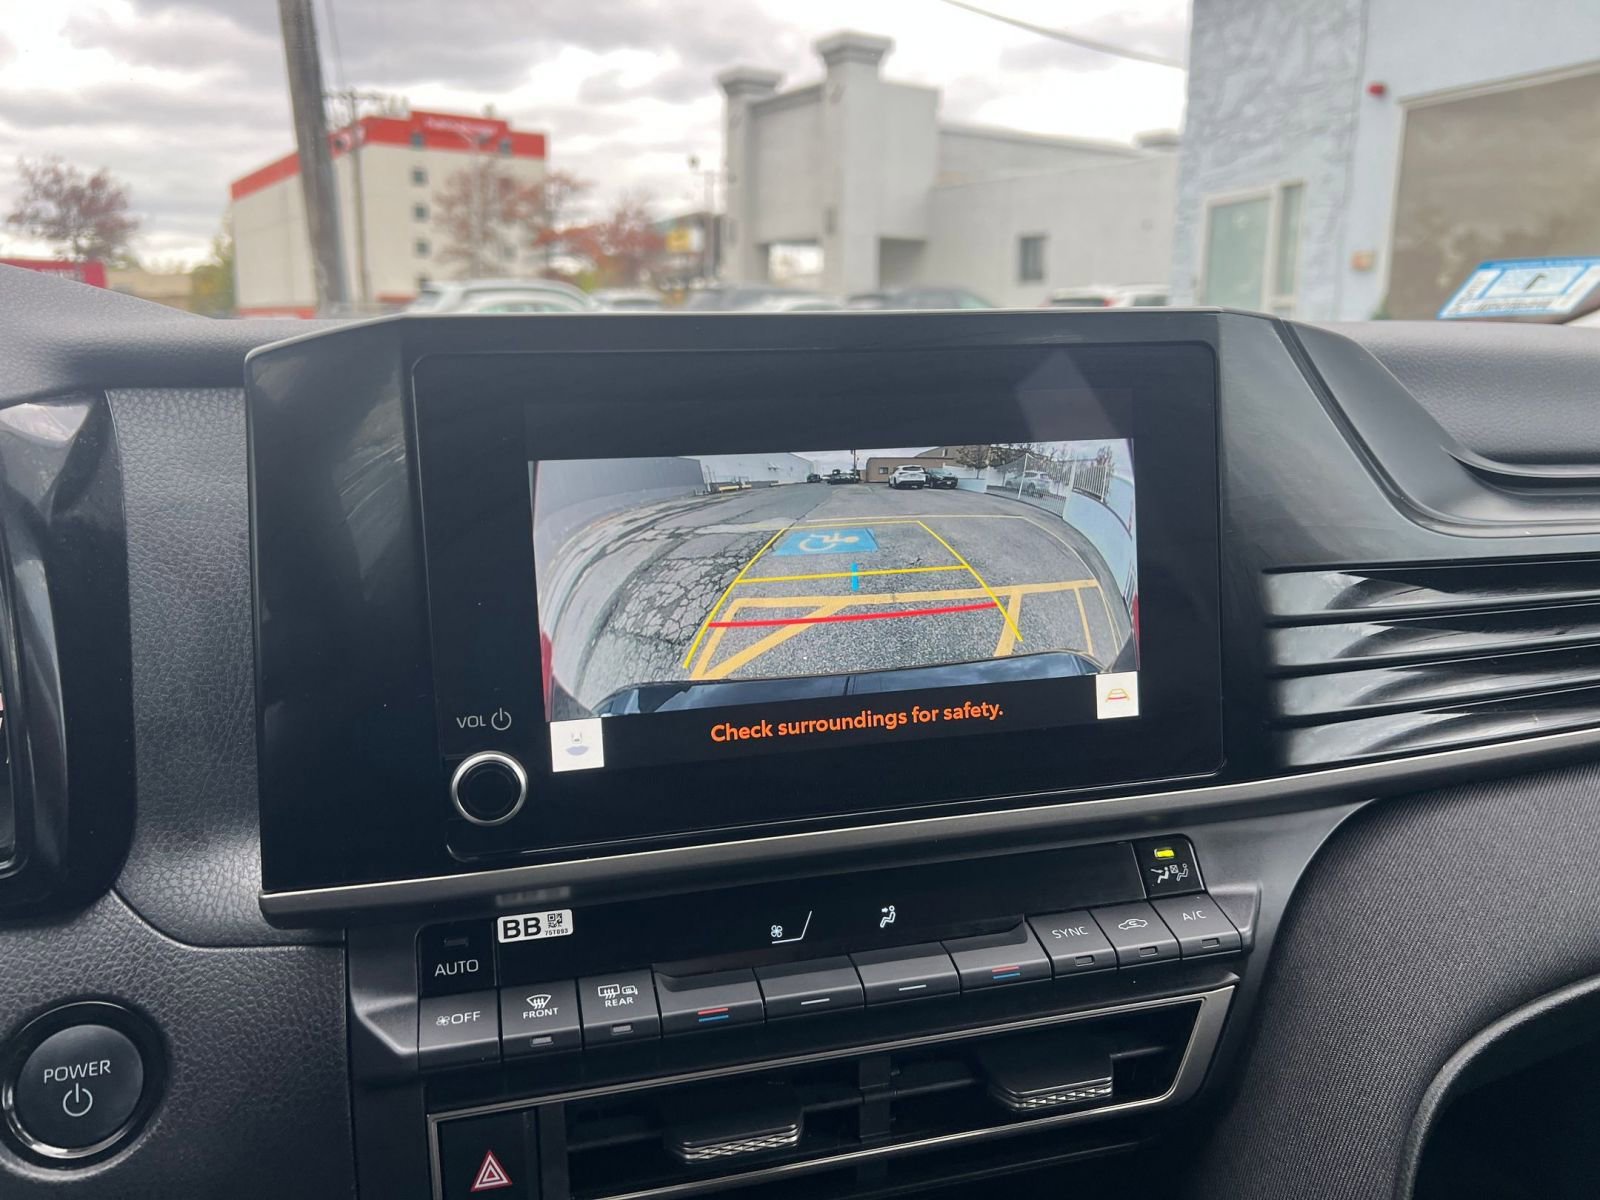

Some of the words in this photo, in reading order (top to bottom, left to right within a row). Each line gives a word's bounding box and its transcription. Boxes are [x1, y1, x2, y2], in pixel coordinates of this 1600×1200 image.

[456, 715, 486, 729] VOL
[710, 720, 773, 742] Check
[777, 709, 908, 736] surroundings
[911, 705, 940, 723] for
[943, 700, 1004, 722] safety.
[1182, 910, 1207, 921] A/C
[502, 917, 541, 939] BB
[1051, 926, 1088, 939] SYNC
[434, 959, 479, 976] AUTO
[604, 995, 634, 1008] REAR
[451, 1011, 481, 1024] OFF
[522, 1007, 558, 1019] FRONT
[44, 1060, 111, 1084] POWER
